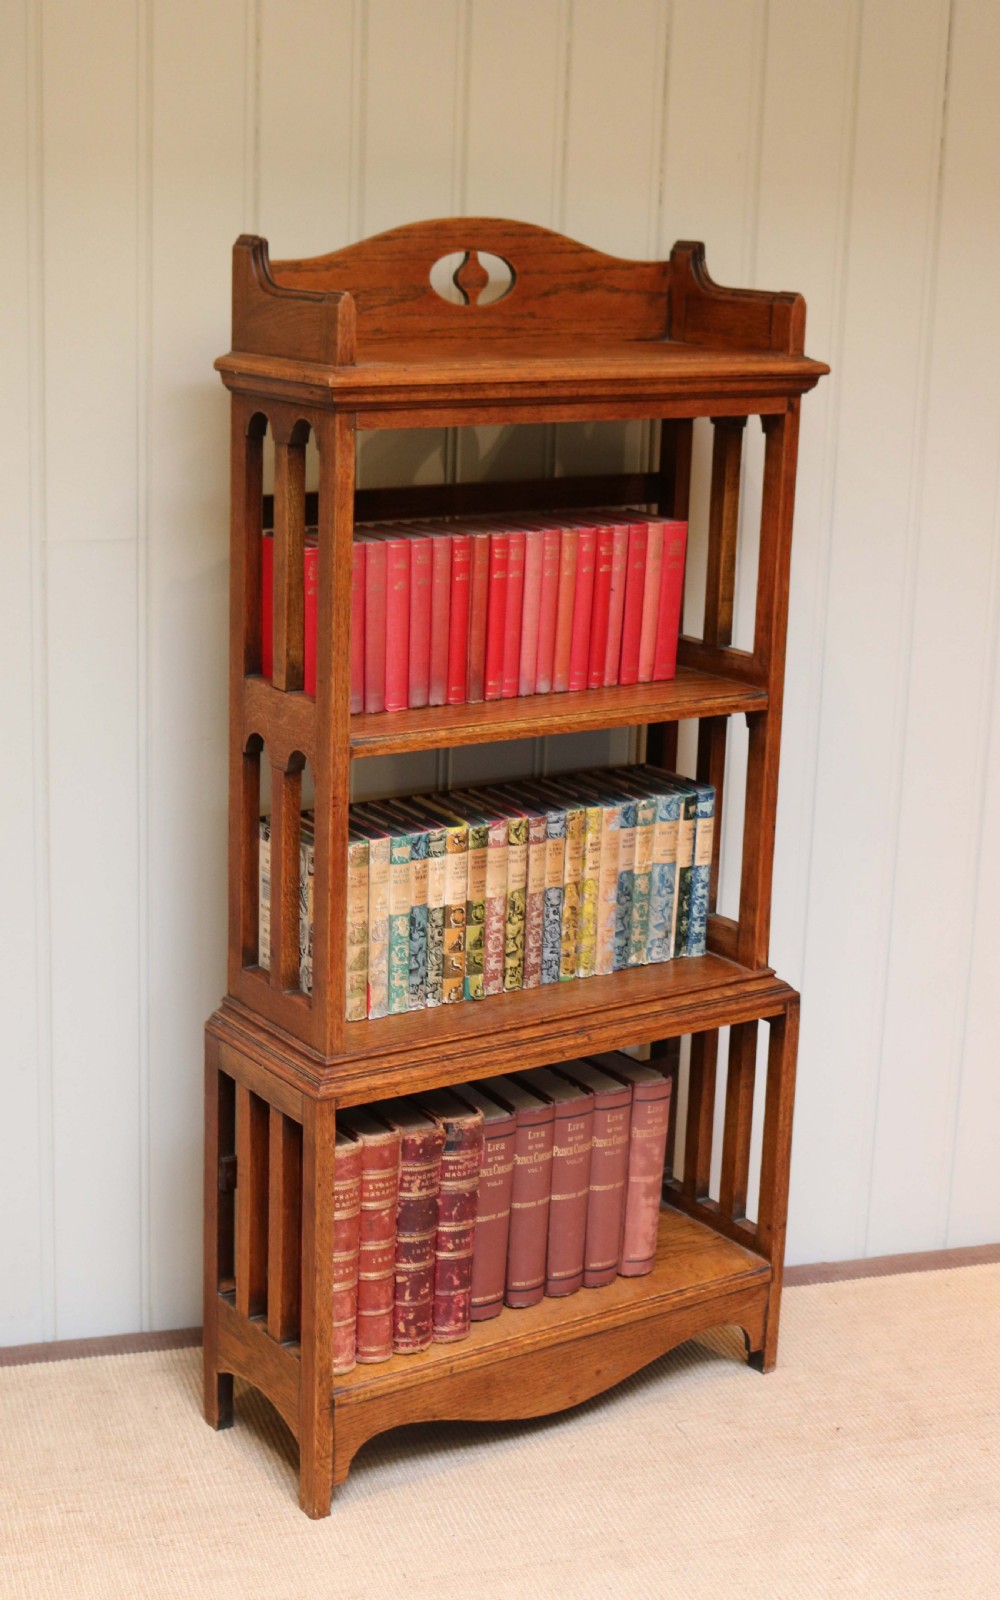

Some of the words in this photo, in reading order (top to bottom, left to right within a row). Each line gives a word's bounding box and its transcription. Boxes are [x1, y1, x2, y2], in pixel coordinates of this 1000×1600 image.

[568, 1122, 585, 1132] LIFE
[528, 1131, 545, 1140] LIFE
[487, 1143, 505, 1152] LIFE
[553, 1145, 573, 1157] PRINCE
[513, 1154, 533, 1165] PRINCE
